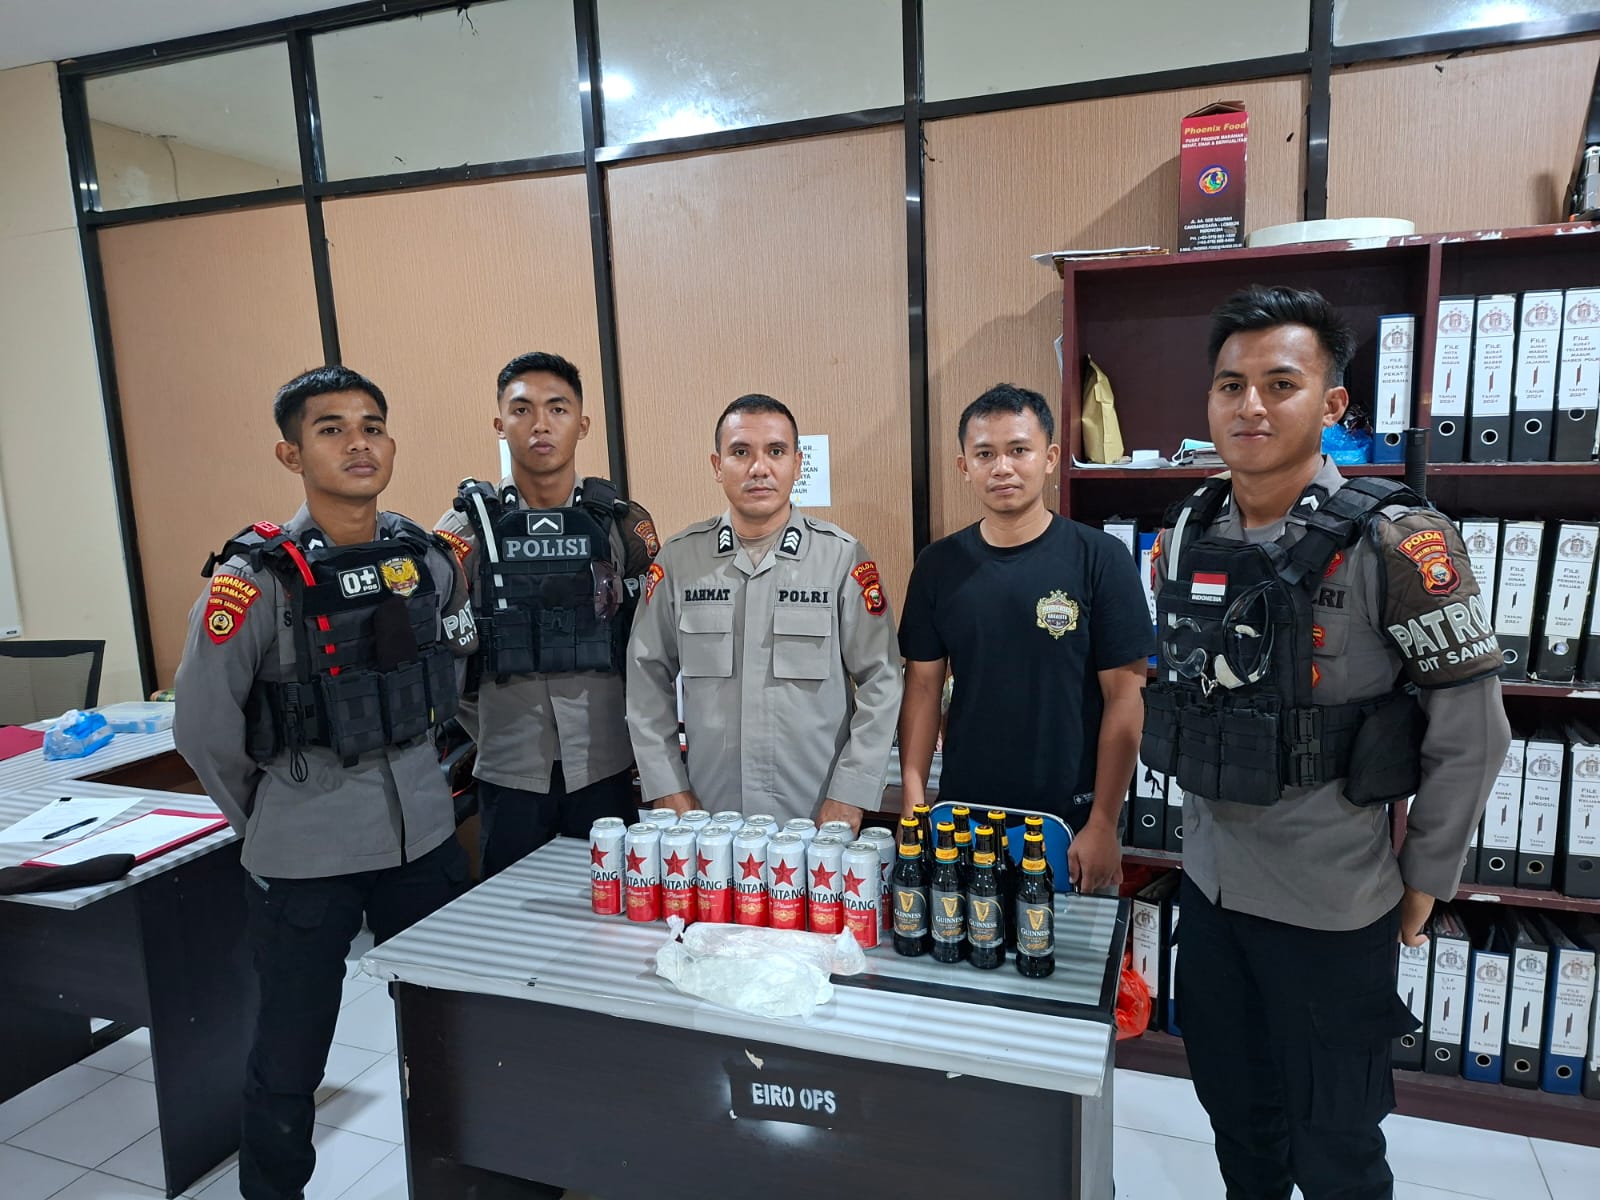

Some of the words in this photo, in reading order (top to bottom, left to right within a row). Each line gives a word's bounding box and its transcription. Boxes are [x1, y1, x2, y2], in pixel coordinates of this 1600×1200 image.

[1184, 125, 1221, 135] Phoenix
[1223, 122, 1246, 131] Food
[1404, 532, 1441, 551] POLDA
[506, 539, 587, 558] POLISI
[855, 563, 875, 576] POLDA
[685, 589, 730, 601] RAHMAT
[779, 590, 828, 603] POLRI
[1191, 594, 1222, 602] INDONESIA
[459, 631, 474, 646] DIT
[1418, 655, 1440, 673] DIT
[895, 909, 921, 919] GUINNESS
[800, 1088, 836, 1114] OPS
